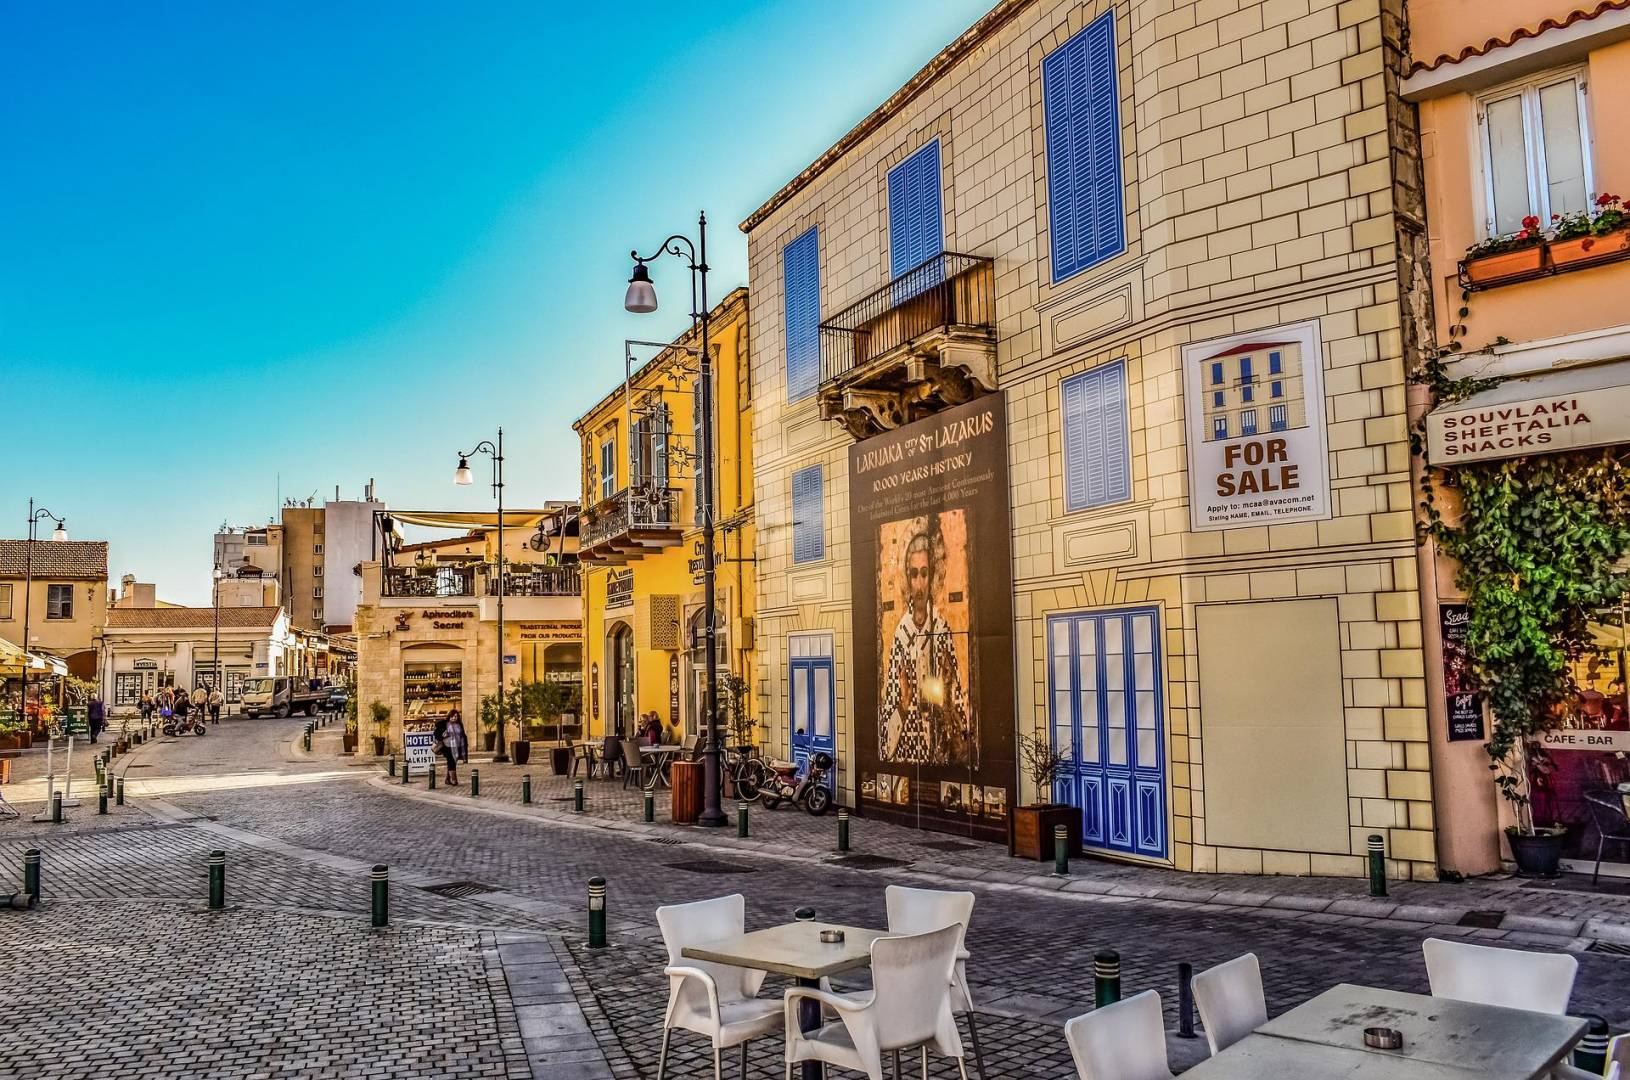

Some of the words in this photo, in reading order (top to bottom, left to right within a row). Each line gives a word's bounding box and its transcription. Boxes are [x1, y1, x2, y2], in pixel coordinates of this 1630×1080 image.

[1443, 399, 1577, 429] SOUVLAKI
[1444, 413, 1592, 442] SHEFTALIA
[856, 442, 904, 475] LARNAKA
[904, 437, 919, 449] CITY
[935, 411, 994, 449] LAZARUS
[1445, 432, 1552, 456] SNACKS
[1224, 438, 1288, 469] FOR
[900, 465, 929, 486] YEARS
[930, 451, 973, 477] HISTORY
[1216, 464, 1300, 497] SALE
[1207, 504, 1228, 513] Apply
[422, 610, 474, 620] Aphrodite's
[433, 620, 464, 630] Secret
[406, 735, 433, 746] HOTEL
[1544, 734, 1576, 744] CAFE
[1587, 736, 1613, 745] BAR
[408, 756, 434, 764] ALKISTI
[412, 748, 429, 756] CITY
